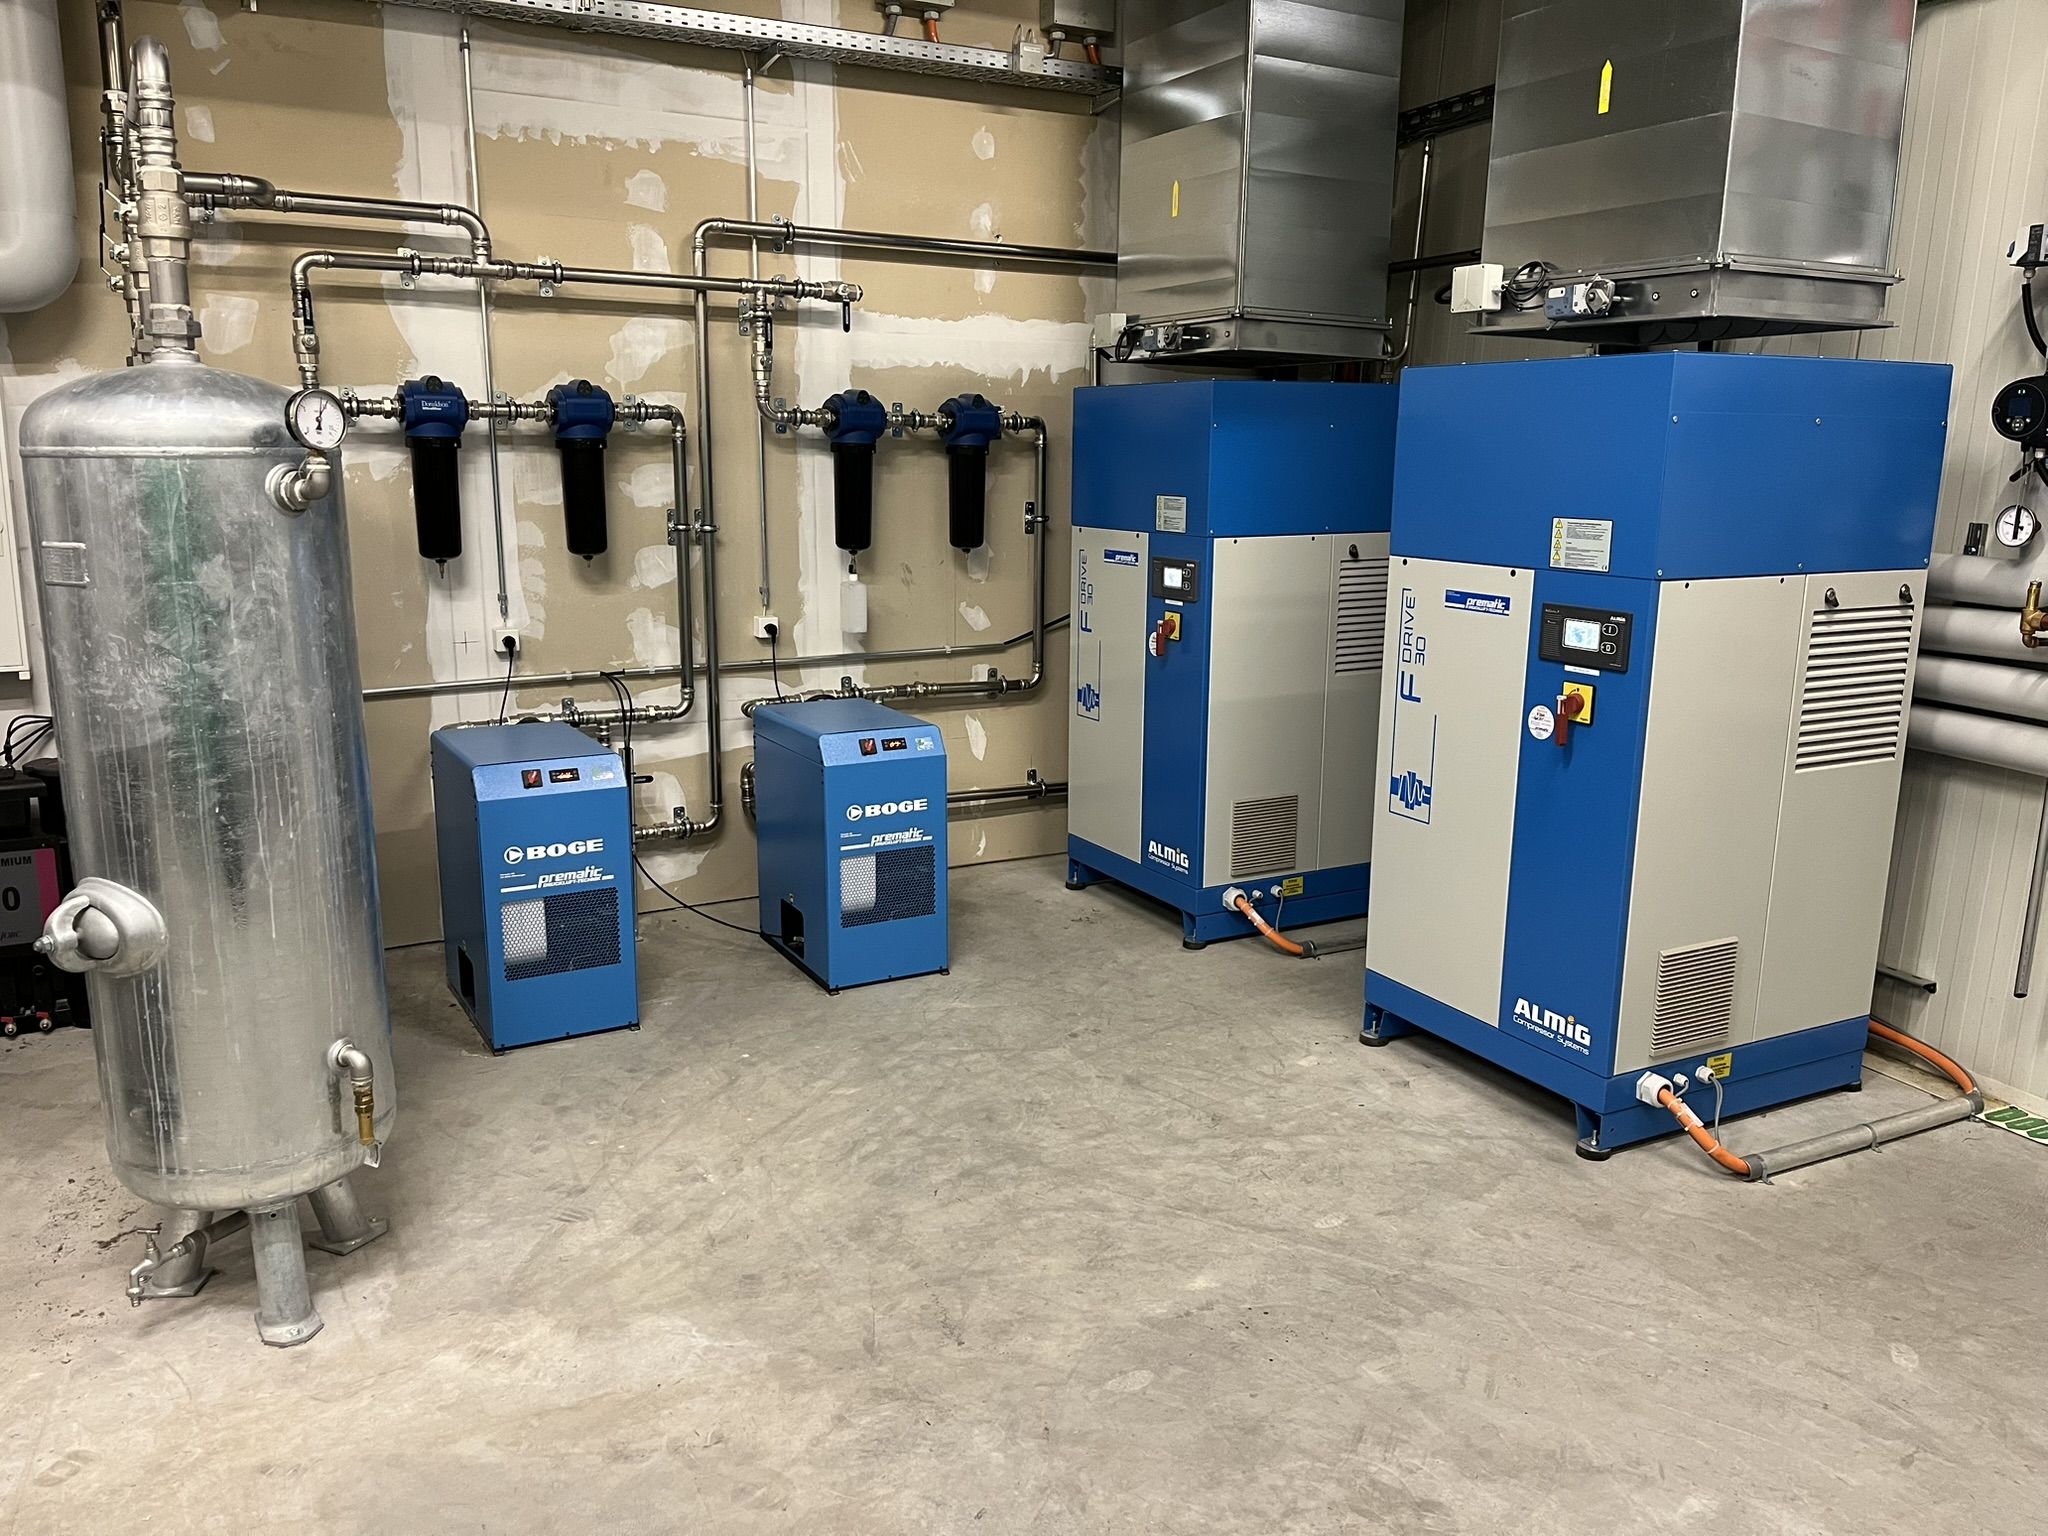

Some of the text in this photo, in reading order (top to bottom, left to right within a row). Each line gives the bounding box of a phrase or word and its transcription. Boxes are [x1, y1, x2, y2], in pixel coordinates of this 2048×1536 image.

[1465, 598, 1507, 611] prematic
[1080, 610, 1092, 633] F
[1400, 596, 1421, 703] F DRIVE
[1415, 636, 1426, 666] 30
[865, 798, 928, 817] BOGE
[870, 827, 924, 847] prematic
[527, 838, 604, 860] BOGE
[537, 865, 604, 889] prematic
[1512, 1014, 1590, 1056] Compressor Systems
